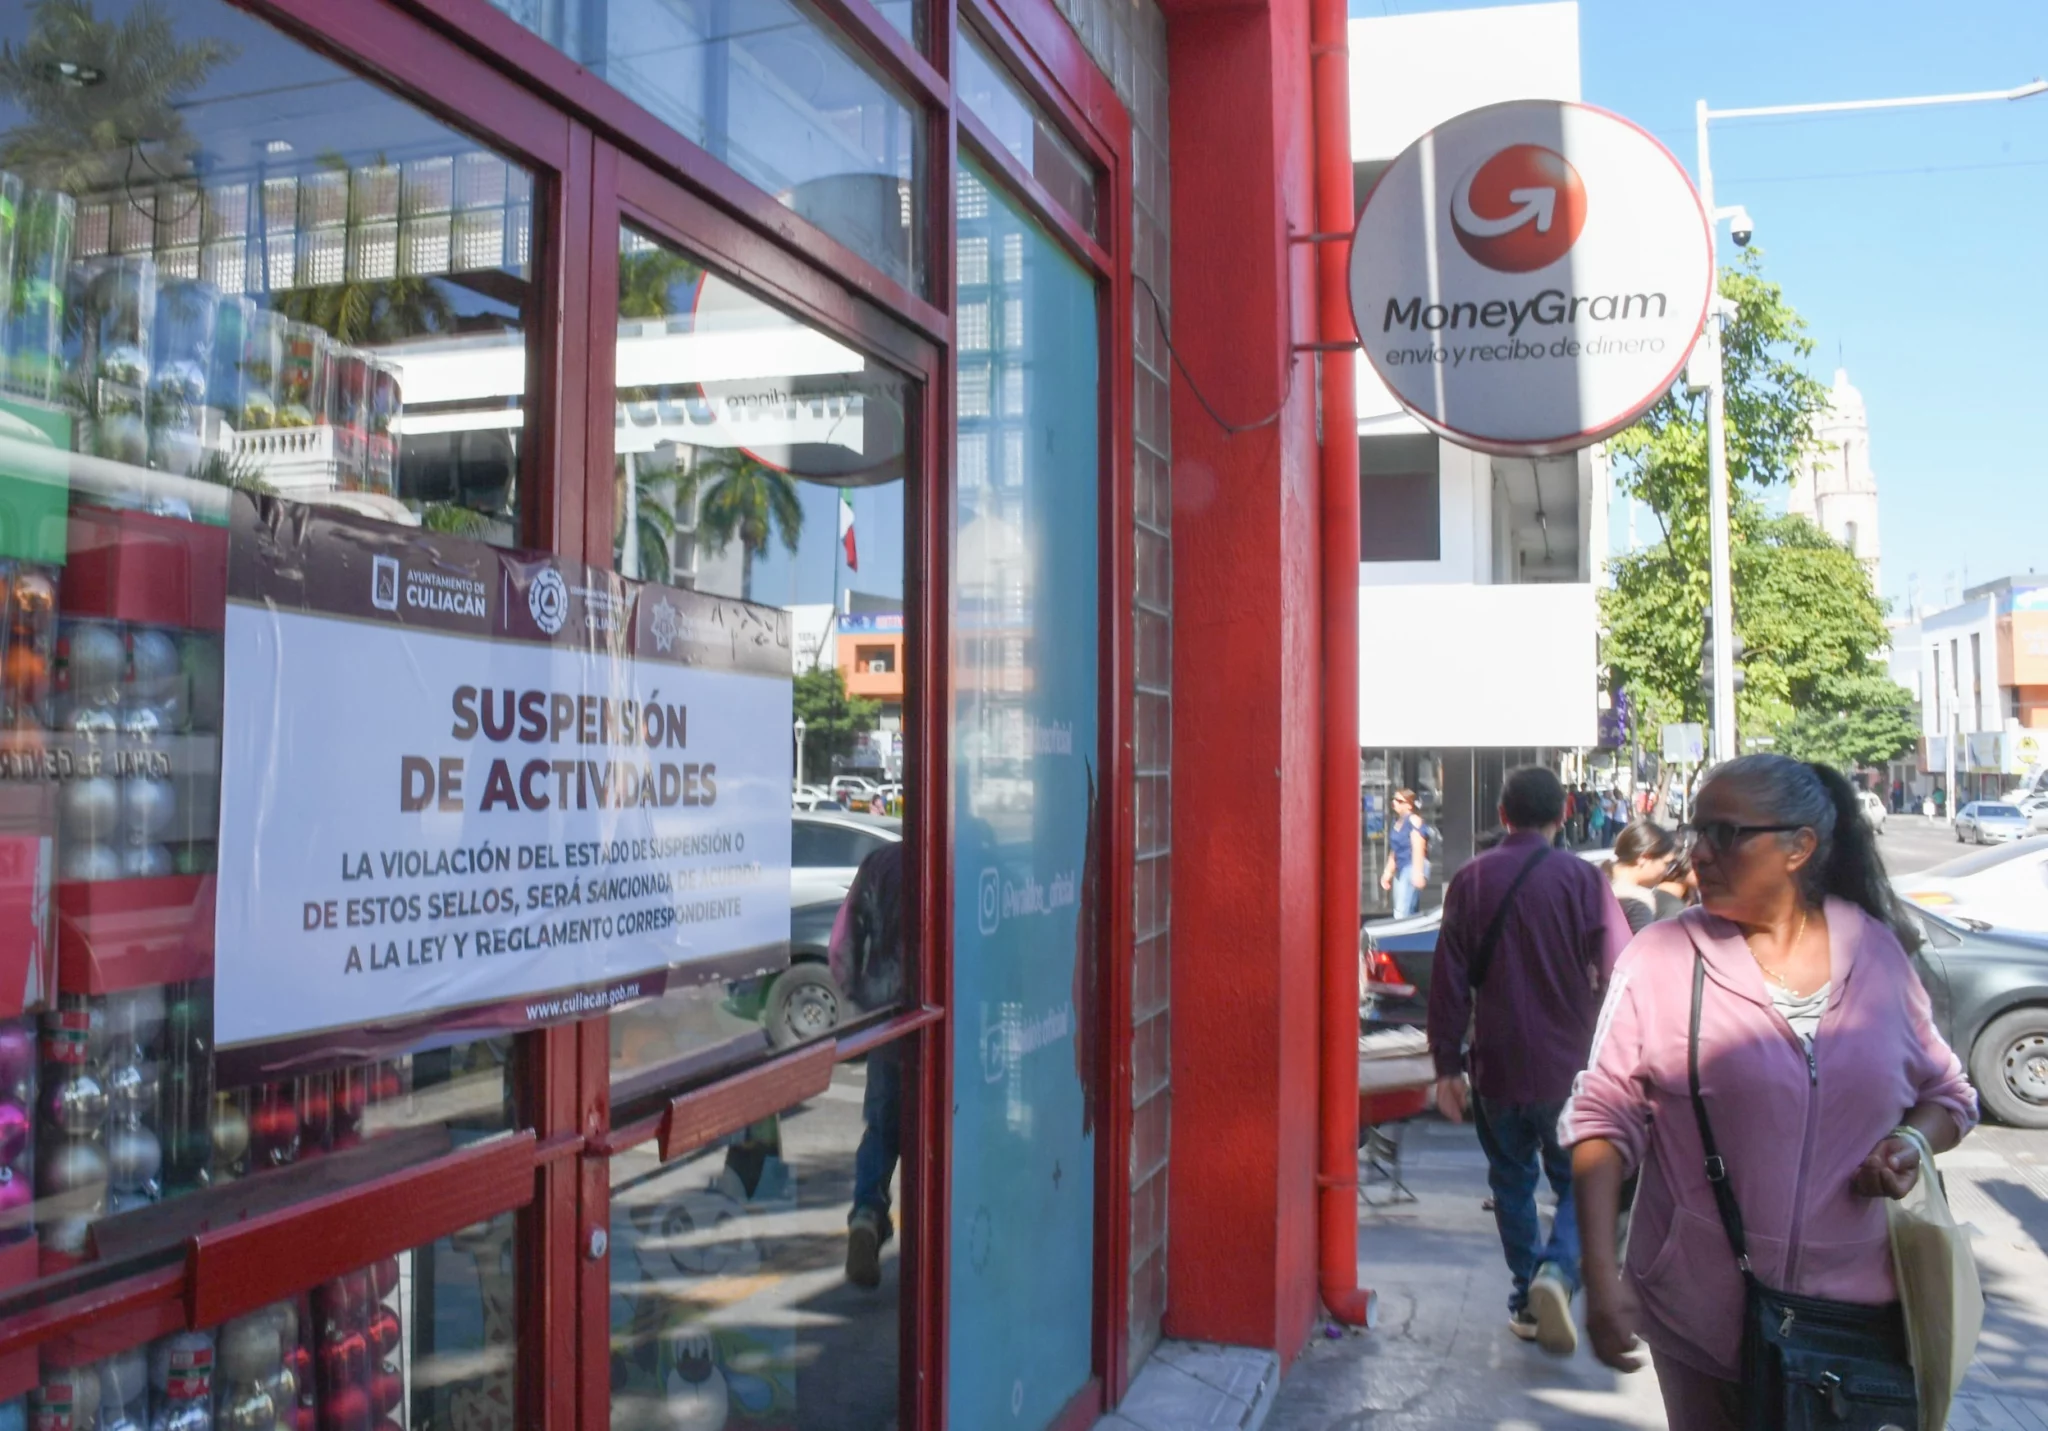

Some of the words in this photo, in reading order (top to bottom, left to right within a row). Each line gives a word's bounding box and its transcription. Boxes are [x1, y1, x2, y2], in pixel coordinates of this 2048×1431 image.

[1384, 289, 1667, 336] MoneyGram
[1451, 347, 1468, 368] y
[1470, 338, 1546, 363] recibo
[1548, 335, 1581, 359] de
[1585, 334, 1665, 356] dinero
[406, 584, 486, 618] CULIACÁN
[407, 569, 473, 594] AYUNTAMIENTO
[474, 580, 485, 595] DE
[451, 683, 687, 750] SUSPENSIÓN
[400, 755, 465, 814] DE
[479, 757, 717, 812] ACTIVIDADES
[341, 851, 374, 881] LA
[380, 840, 510, 880] VIOLACIÓN
[517, 844, 559, 870] DEL
[565, 838, 629, 868] ESTADO
[631, 838, 648, 861] DE
[734, 832, 745, 852] O
[303, 900, 338, 931] DE
[346, 894, 421, 927] ESTOS
[427, 887, 520, 920] SELLOS,
[526, 876, 582, 911] SERÁ
[586, 873, 674, 906] SANCIONADA
[344, 945, 363, 974] A
[370, 940, 401, 971] LA
[407, 934, 448, 966] LEY
[453, 931, 468, 959] Y
[475, 916, 614, 957] REGLAMENTO
[616, 897, 742, 939] CORRESPONDIENTE
[525, 983, 640, 1020] www.culiacan.gob.mx
